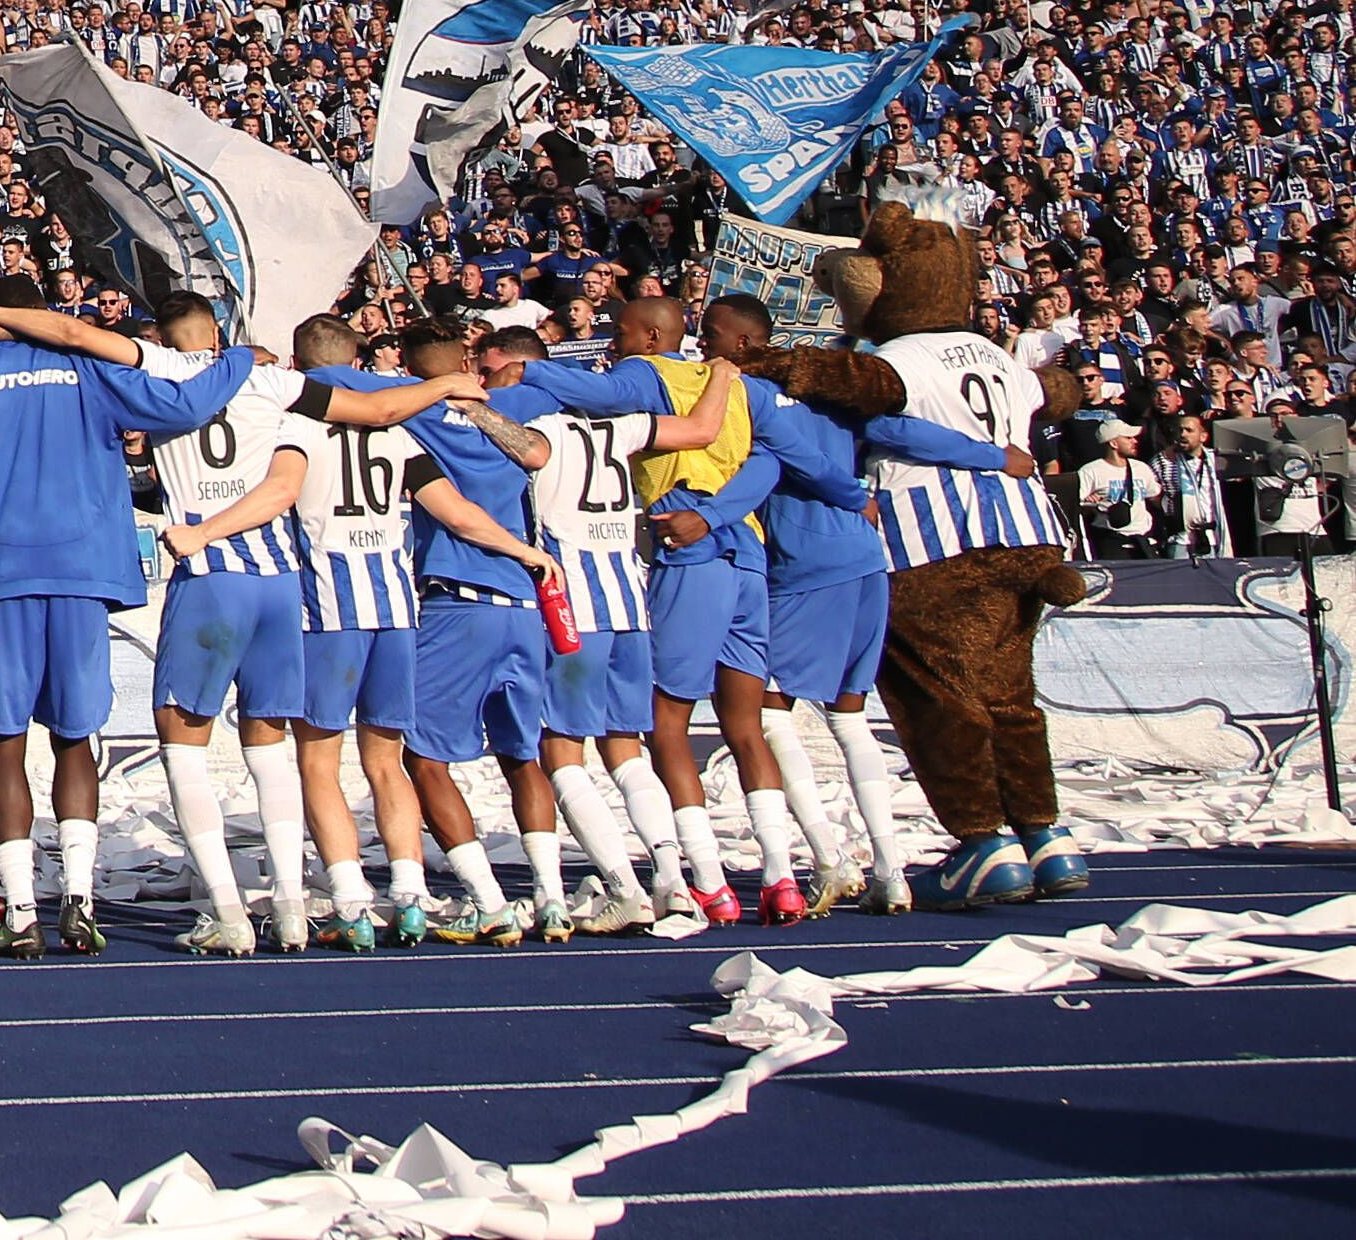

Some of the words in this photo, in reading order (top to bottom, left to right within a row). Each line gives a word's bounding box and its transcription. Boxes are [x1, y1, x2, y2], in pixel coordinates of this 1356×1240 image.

[716, 222, 837, 274] HAUPT
[197, 478, 246, 502] SERDAR
[327, 424, 393, 517] 16
[566, 421, 629, 513] 23
